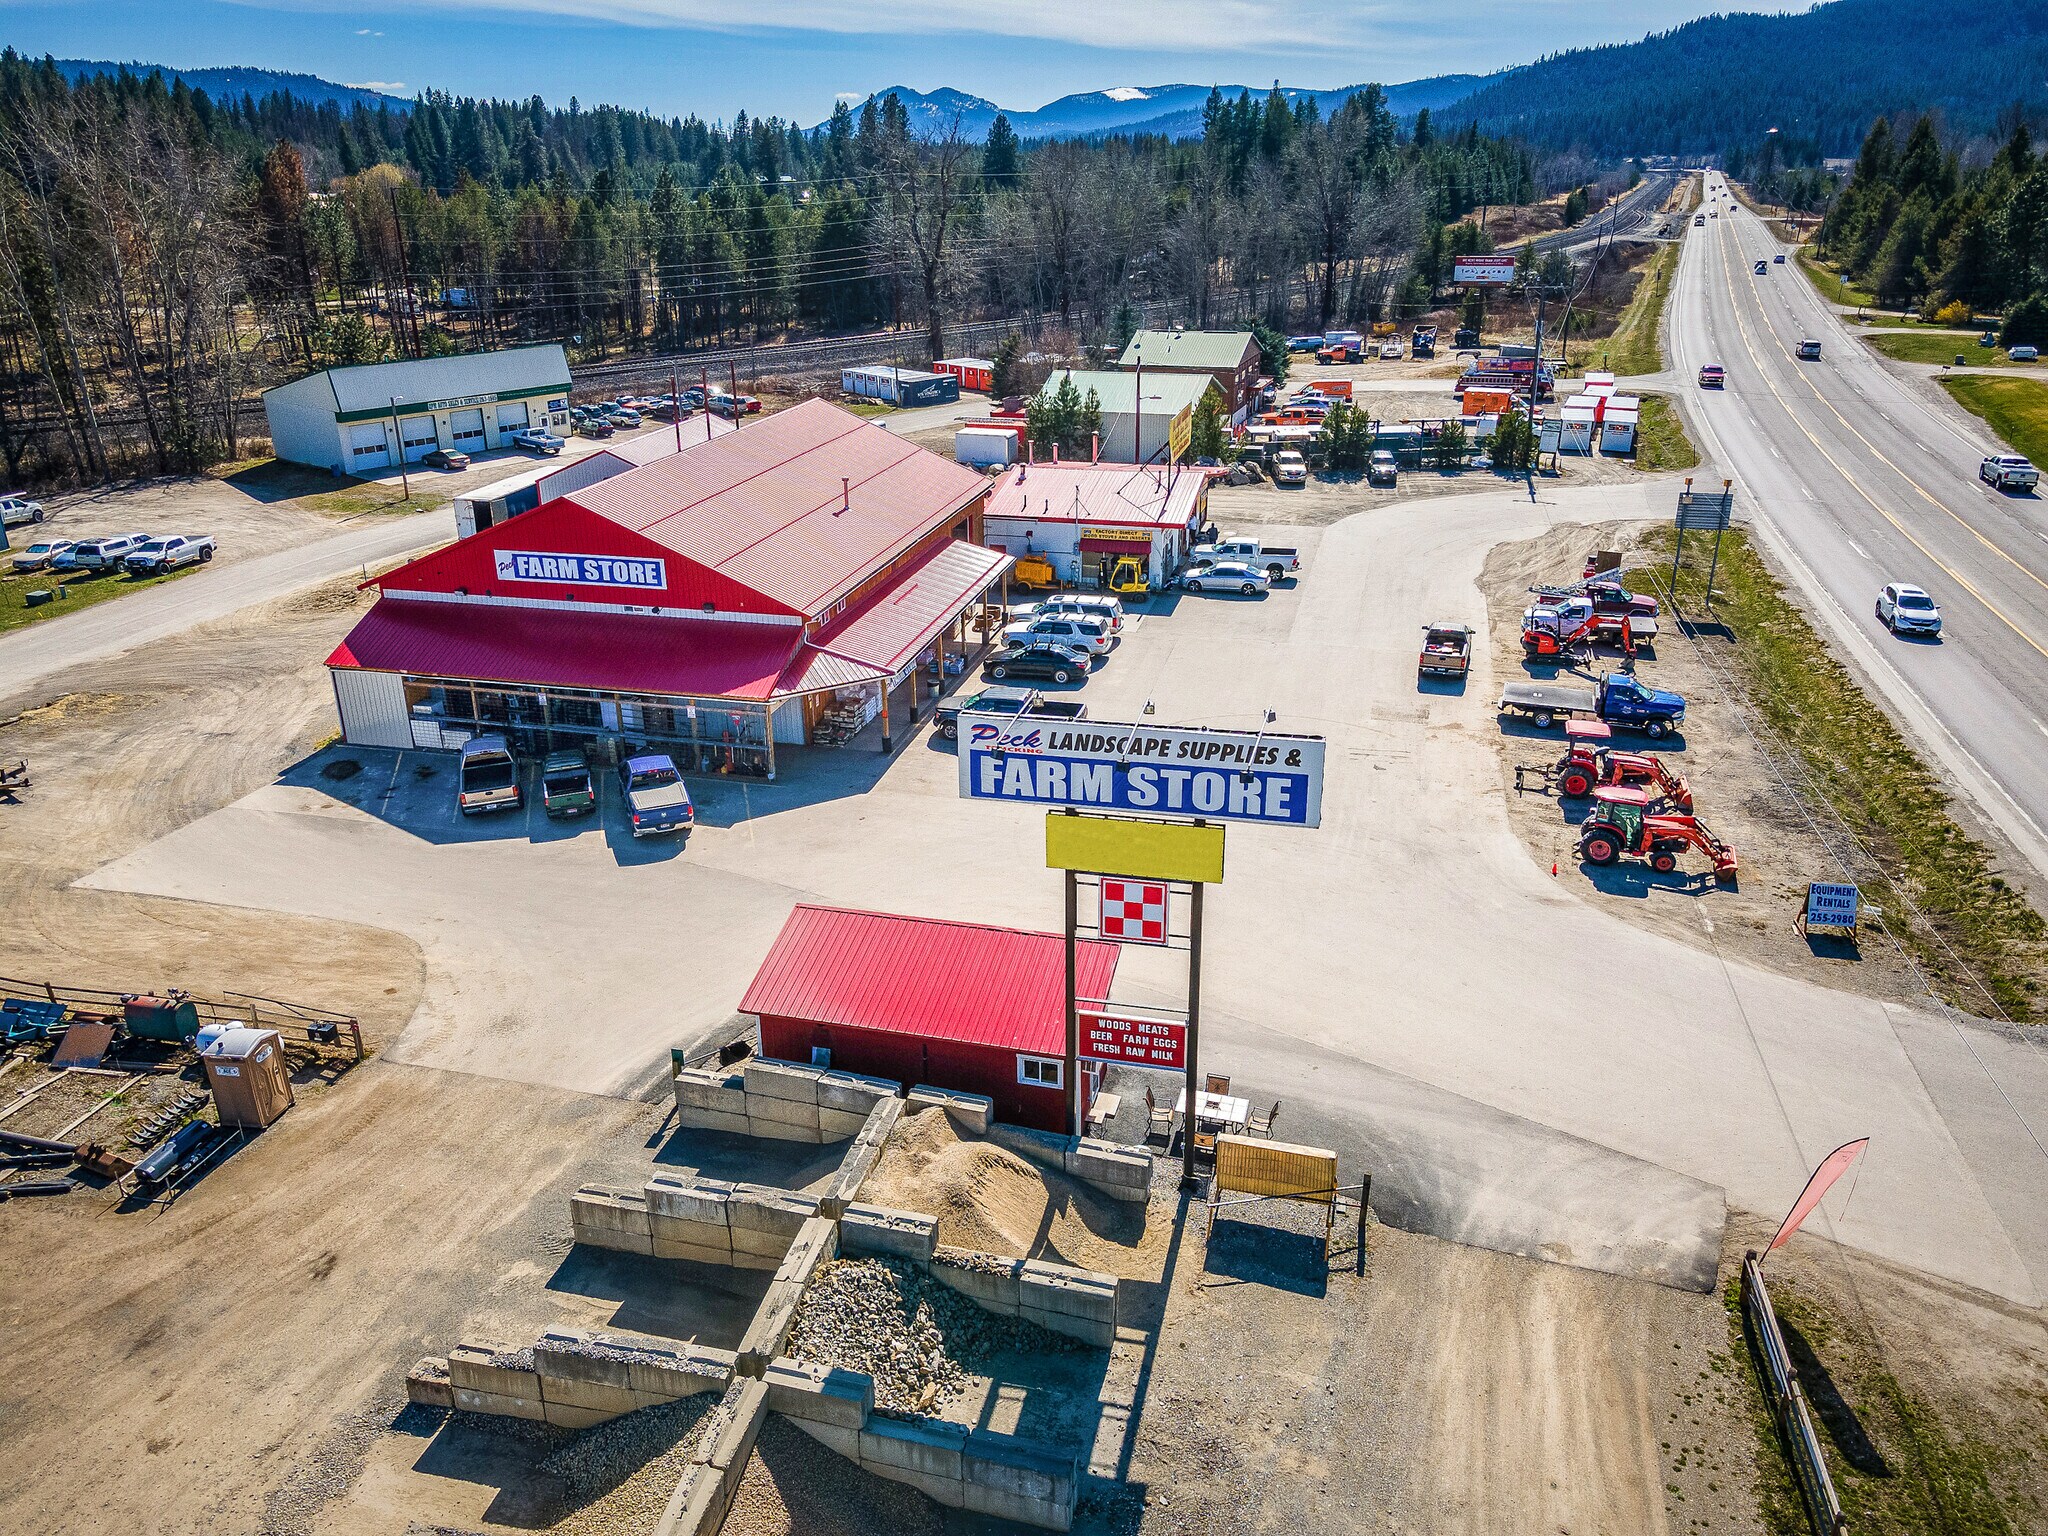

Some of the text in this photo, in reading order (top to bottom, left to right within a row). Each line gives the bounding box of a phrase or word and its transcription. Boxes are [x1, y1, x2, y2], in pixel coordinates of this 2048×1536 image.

[516, 556, 658, 584] FARM STORE
[970, 723, 1043, 748] Peck
[1048, 731, 1301, 767] LANDSCAPE SUPPLIES &
[980, 757, 1291, 818] FARM STORE
[1811, 884, 1856, 897] EQUIPMENT
[1816, 896, 1851, 908] RENTALS
[1810, 912, 1854, 924] 255-2980
[1098, 1019, 1169, 1036] WOODS MEATS
[1090, 1030, 1178, 1049] BEER FARM EGGS
[1093, 1042, 1173, 1061] FRESH RAW MILK
